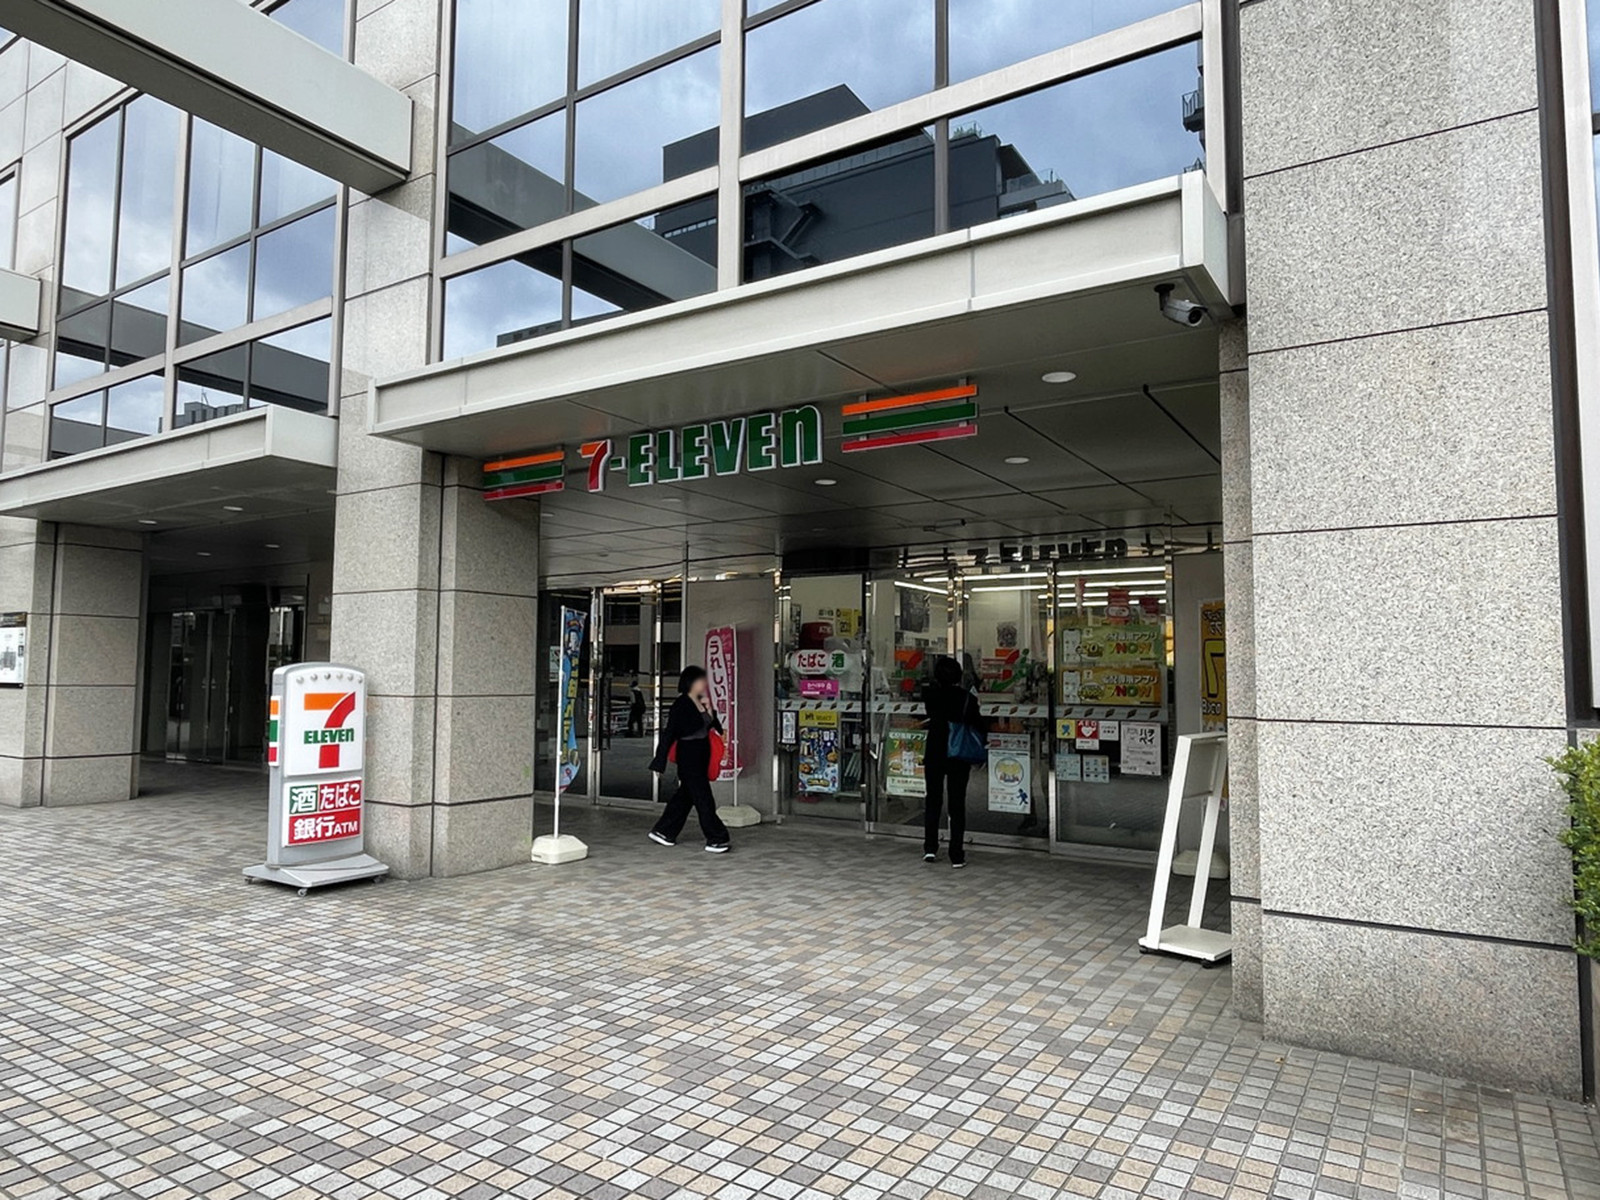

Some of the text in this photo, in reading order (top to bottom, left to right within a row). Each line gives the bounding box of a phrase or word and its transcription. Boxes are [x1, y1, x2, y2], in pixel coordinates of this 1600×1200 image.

[797, 653, 826, 668] たばこ
[831, 653, 845, 668] 酒
[291, 786, 317, 813] 酒
[319, 783, 361, 811] たばこ
[293, 815, 359, 840] 銀行ATM
